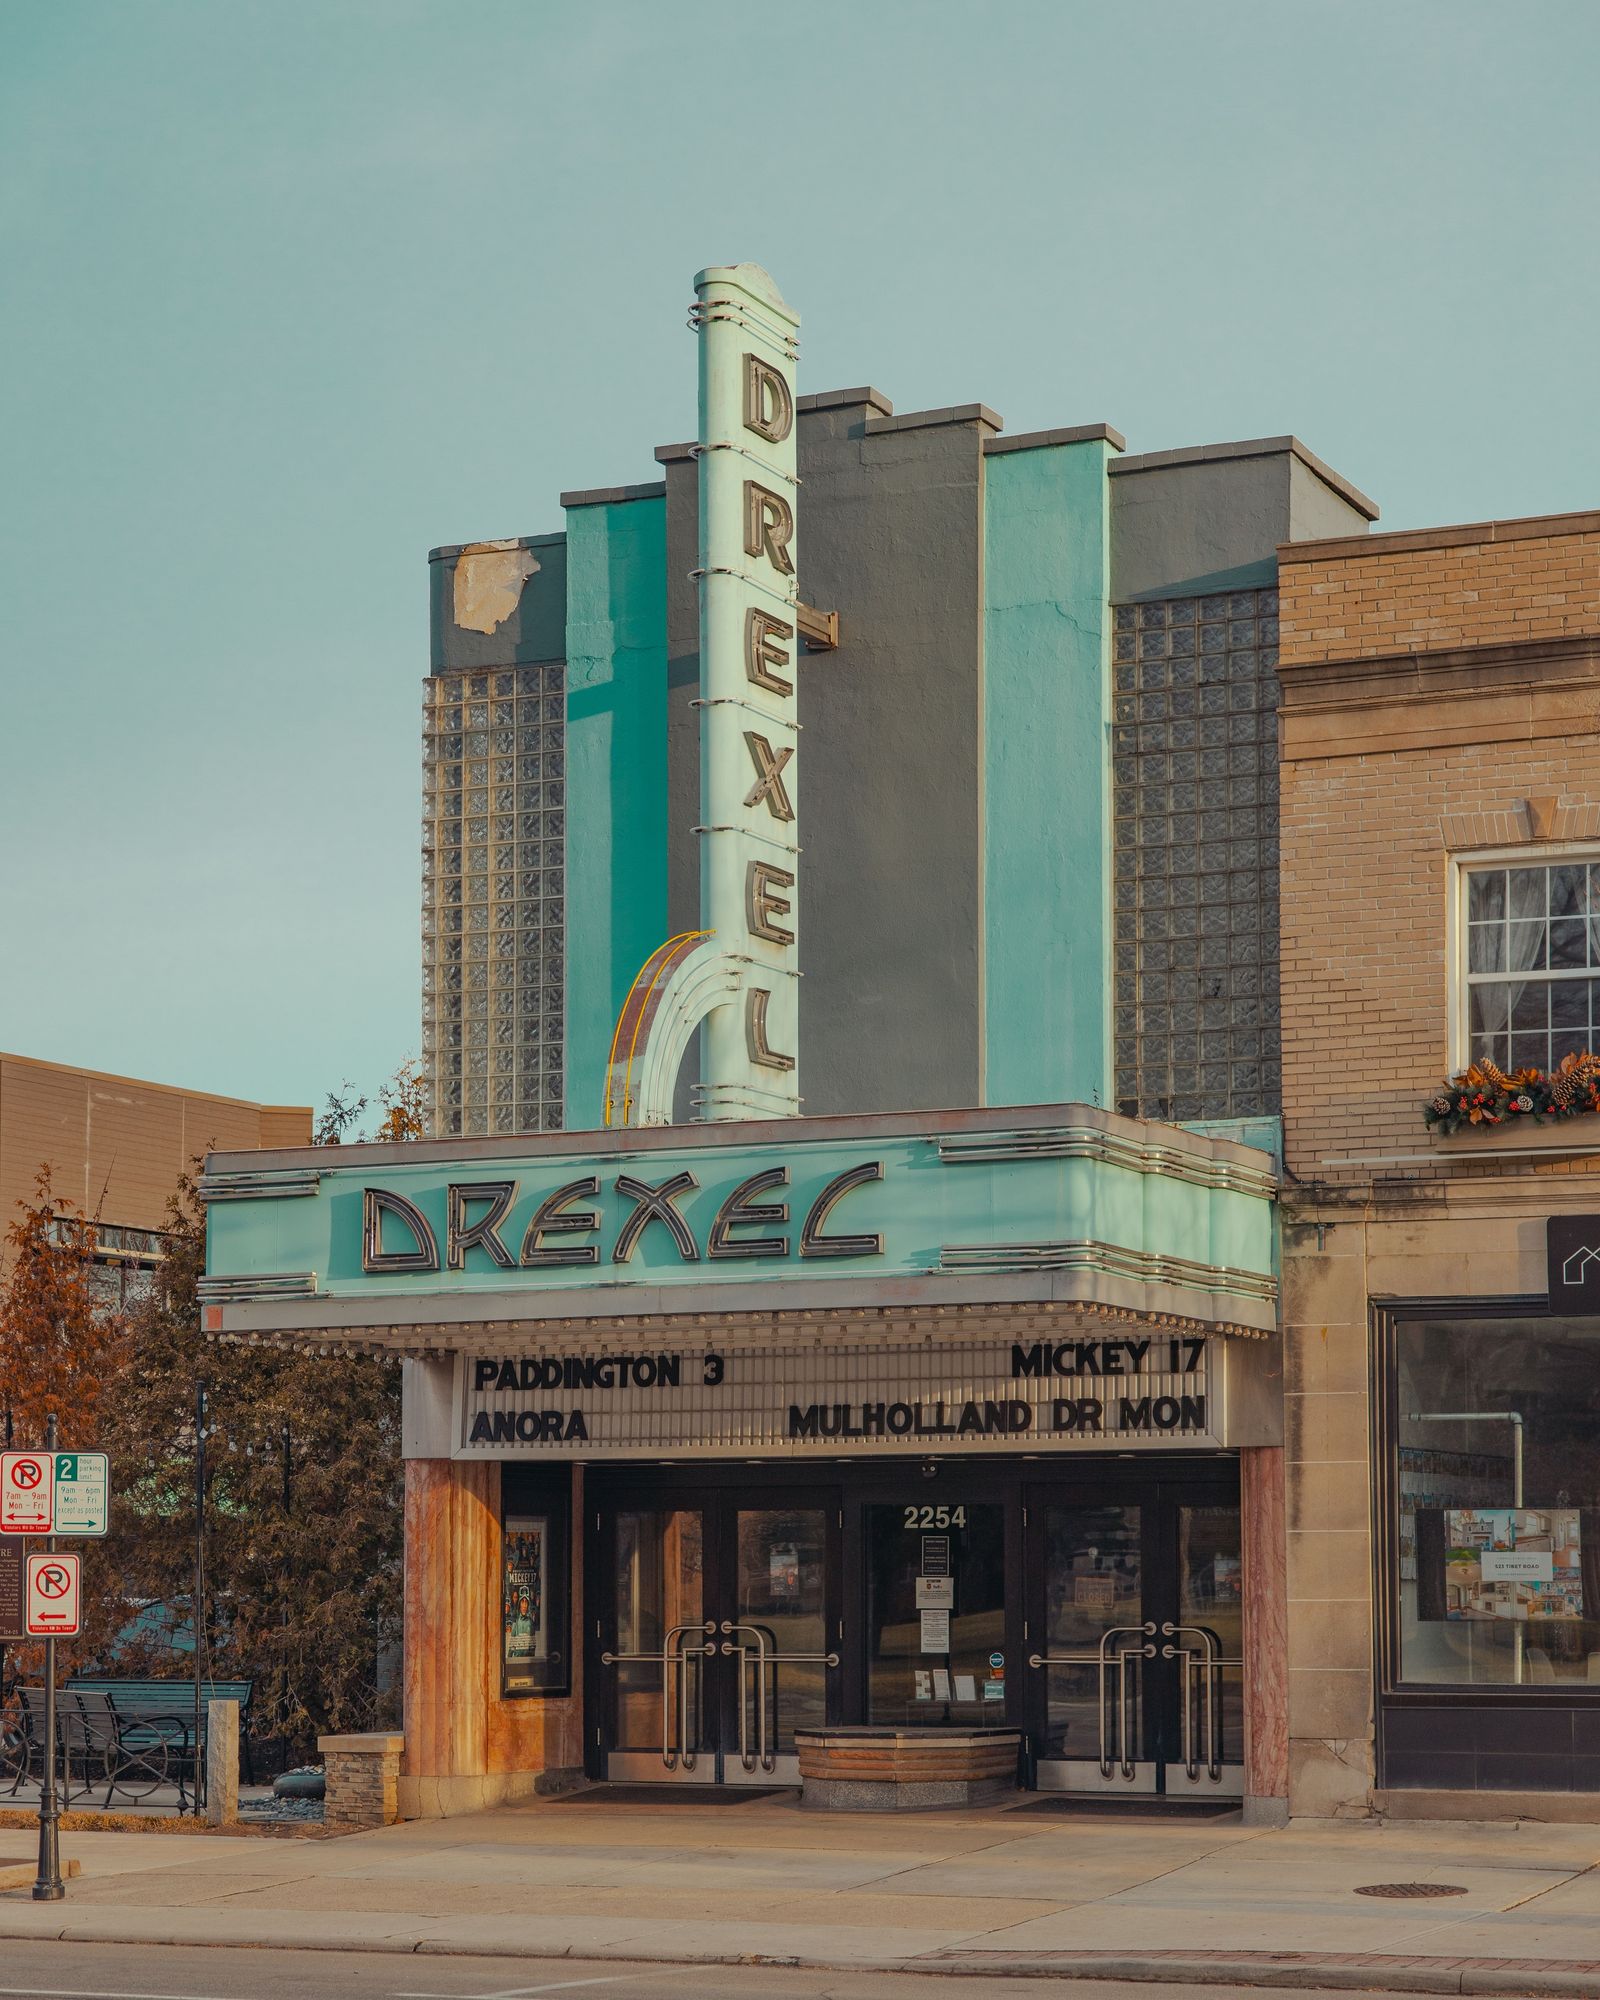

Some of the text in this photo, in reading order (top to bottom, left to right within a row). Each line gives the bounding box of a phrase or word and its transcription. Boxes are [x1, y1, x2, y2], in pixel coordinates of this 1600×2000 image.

[742, 352, 796, 1073] DREXEL
[362, 1160, 884, 1273] DREXEL
[1011, 1339, 1206, 1377] MICKEY 17
[475, 1355, 724, 1391] PADDINGTON 3
[469, 1410, 588, 1442] ANORA
[788, 1395, 1206, 1437] MULHOLLAND DR MON
[61, 1459, 72, 1479] 2
[6, 1492, 21, 1500] 7am
[31, 1492, 47, 1500] 9am
[61, 1486, 76, 1494] 9am
[64, 1496, 78, 1504] Mon
[9, 1501, 23, 1510] Mon
[33, 1501, 44, 1510] Fri
[904, 1506, 967, 1529] 2254
